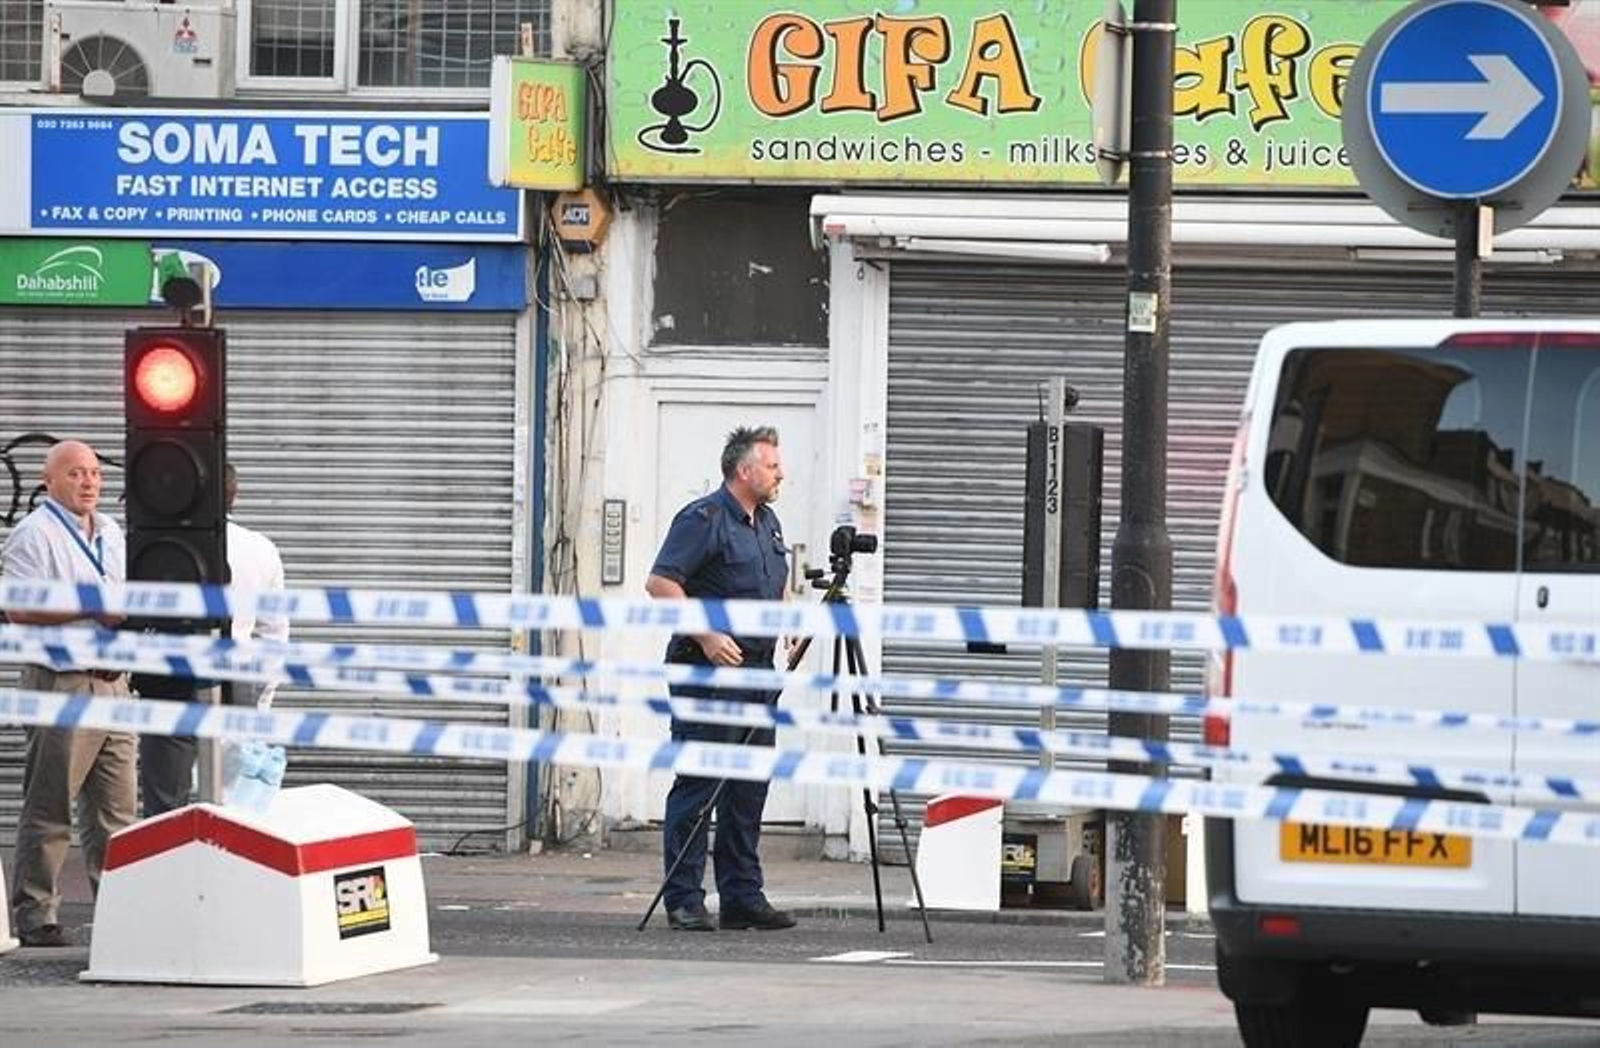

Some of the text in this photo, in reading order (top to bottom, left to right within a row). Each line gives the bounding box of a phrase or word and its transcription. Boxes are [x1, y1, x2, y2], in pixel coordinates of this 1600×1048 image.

[748, 13, 1360, 132] GIFA afe
[117, 121, 440, 167] SOMA TECH
[751, 135, 964, 163] sandwiches
[1227, 139, 1249, 165] &
[117, 174, 438, 200] FAST INTERNET ACCESS
[52, 206, 507, 226] FAX & COPY PRINTING PHONE CARDS CHEAP CALLS
[561, 206, 590, 223] ADT
[1300, 822, 1373, 856] ML16
